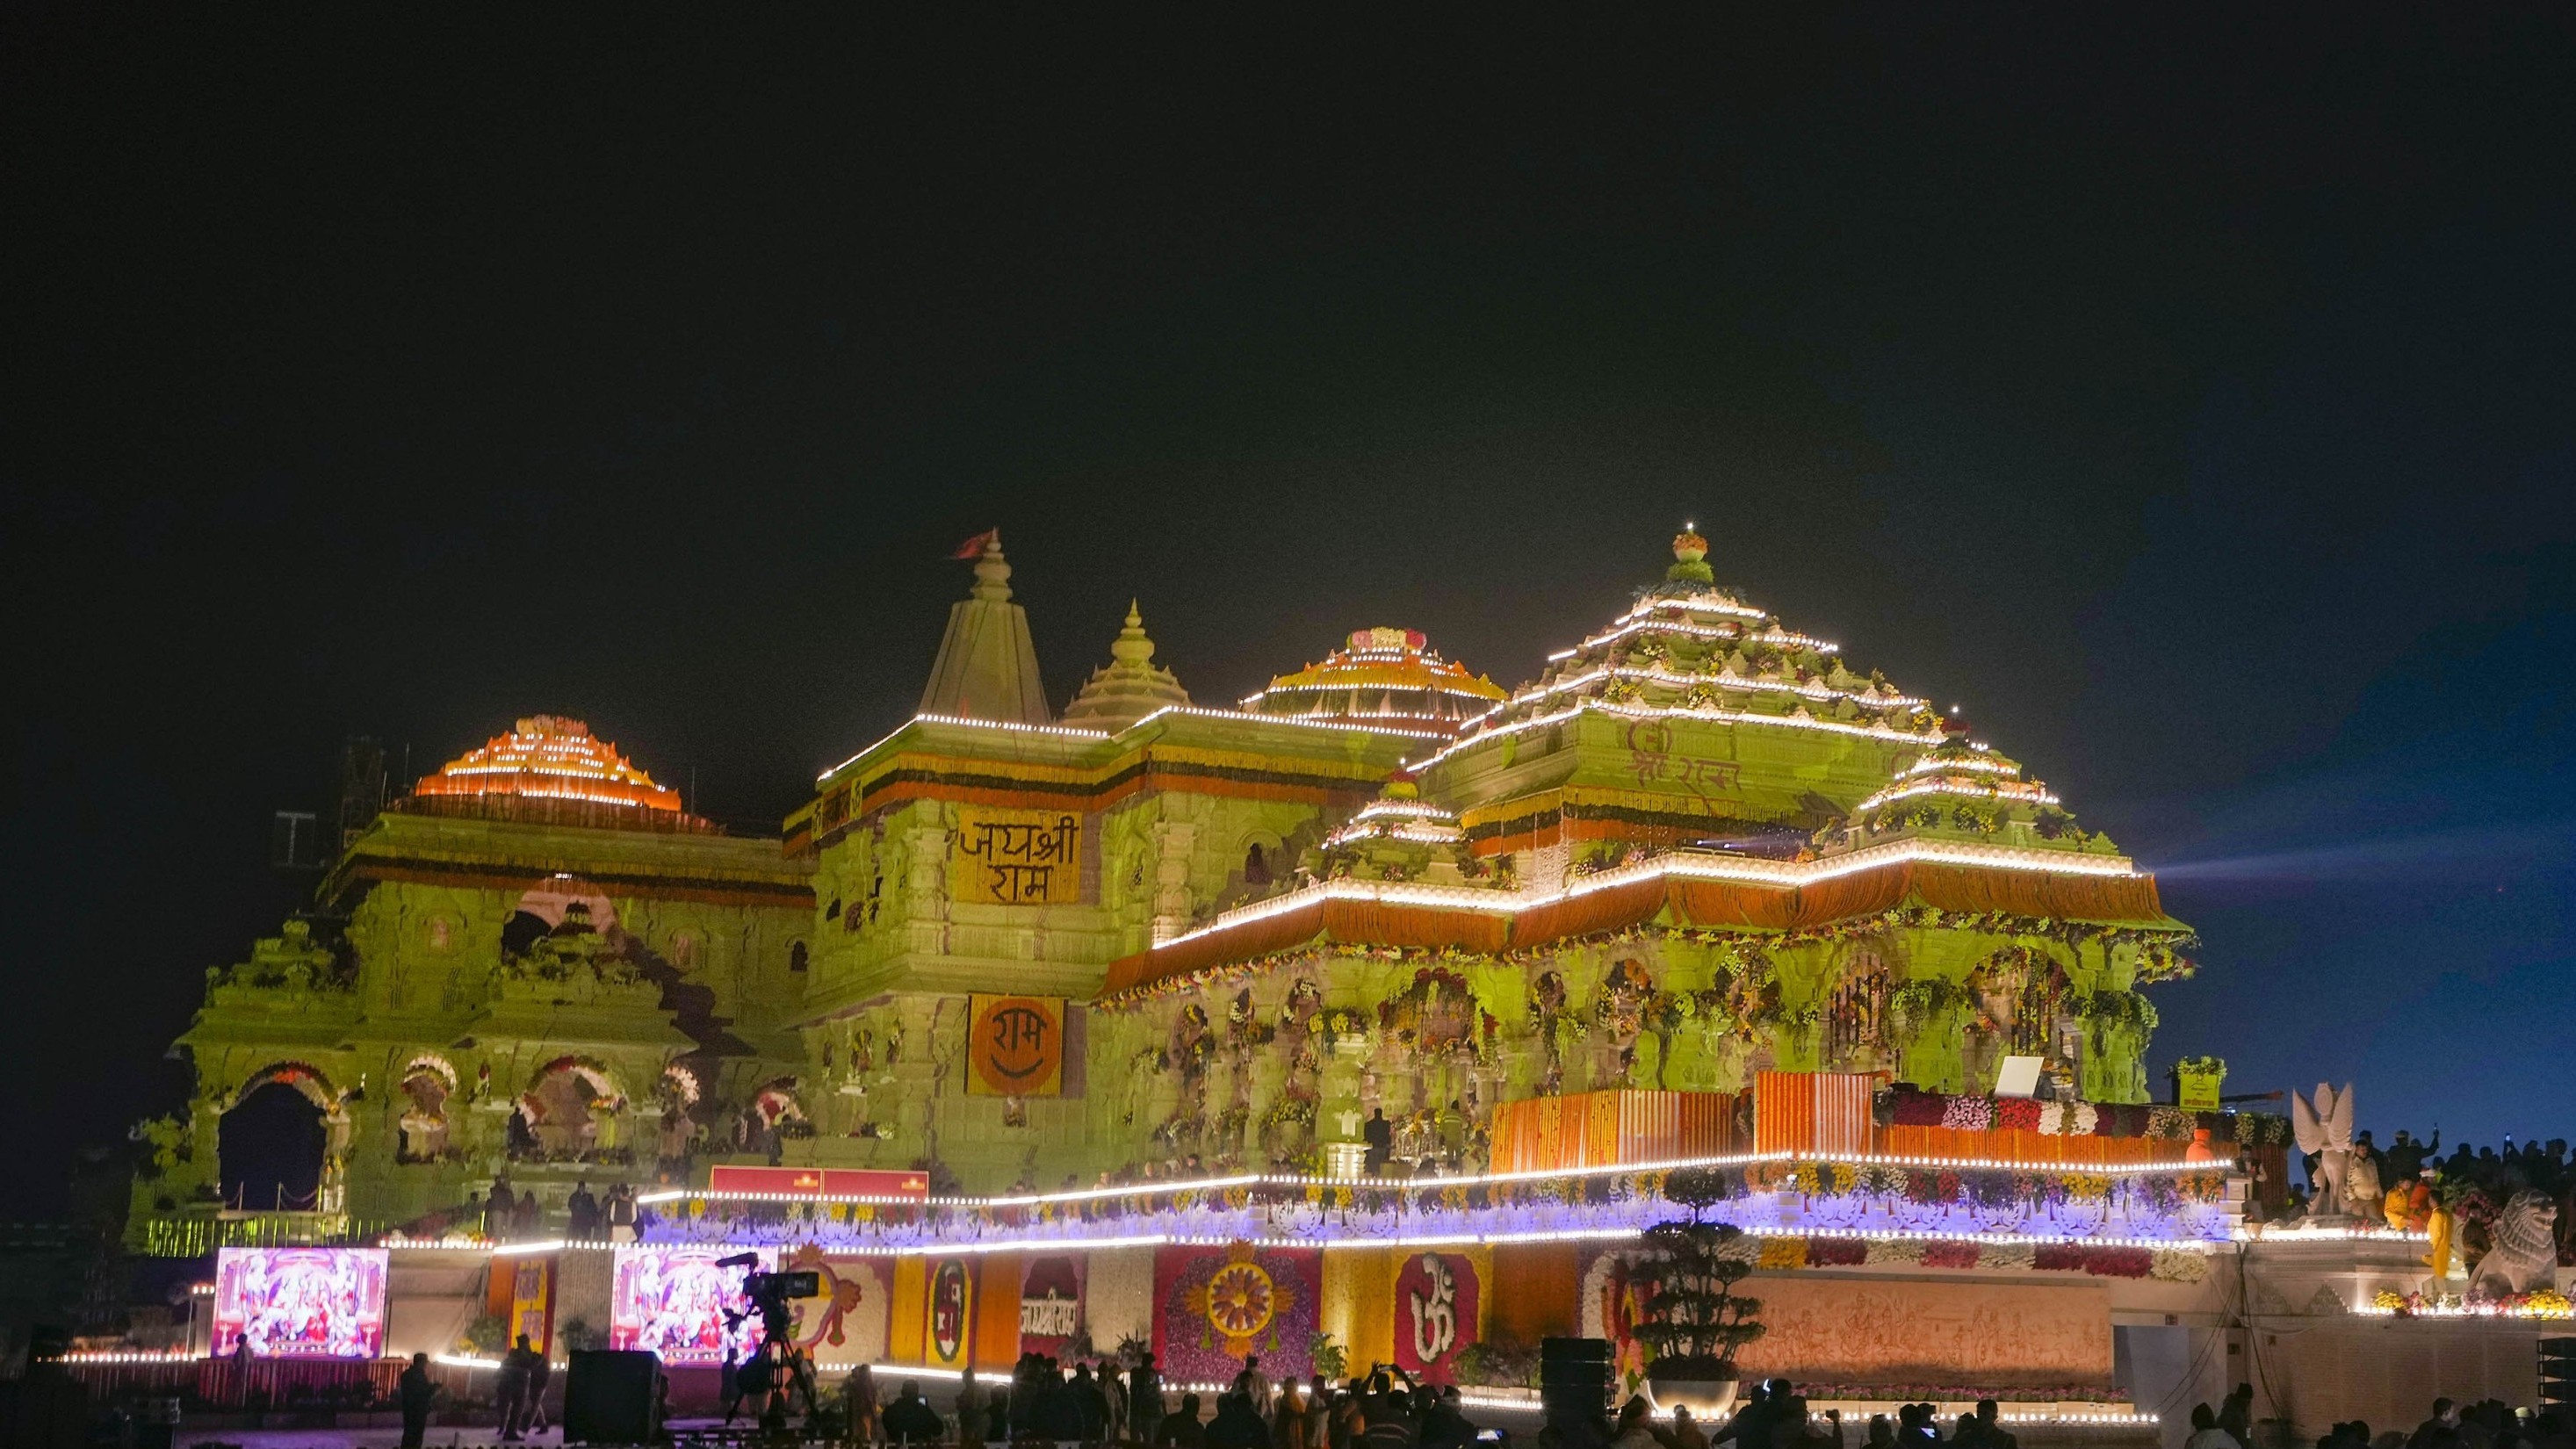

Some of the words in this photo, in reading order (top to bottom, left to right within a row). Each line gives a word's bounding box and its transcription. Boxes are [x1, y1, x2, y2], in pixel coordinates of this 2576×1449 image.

[1678, 755, 1743, 798] राम
[987, 864, 1054, 901] राम
[992, 1007, 1047, 1051] राम
